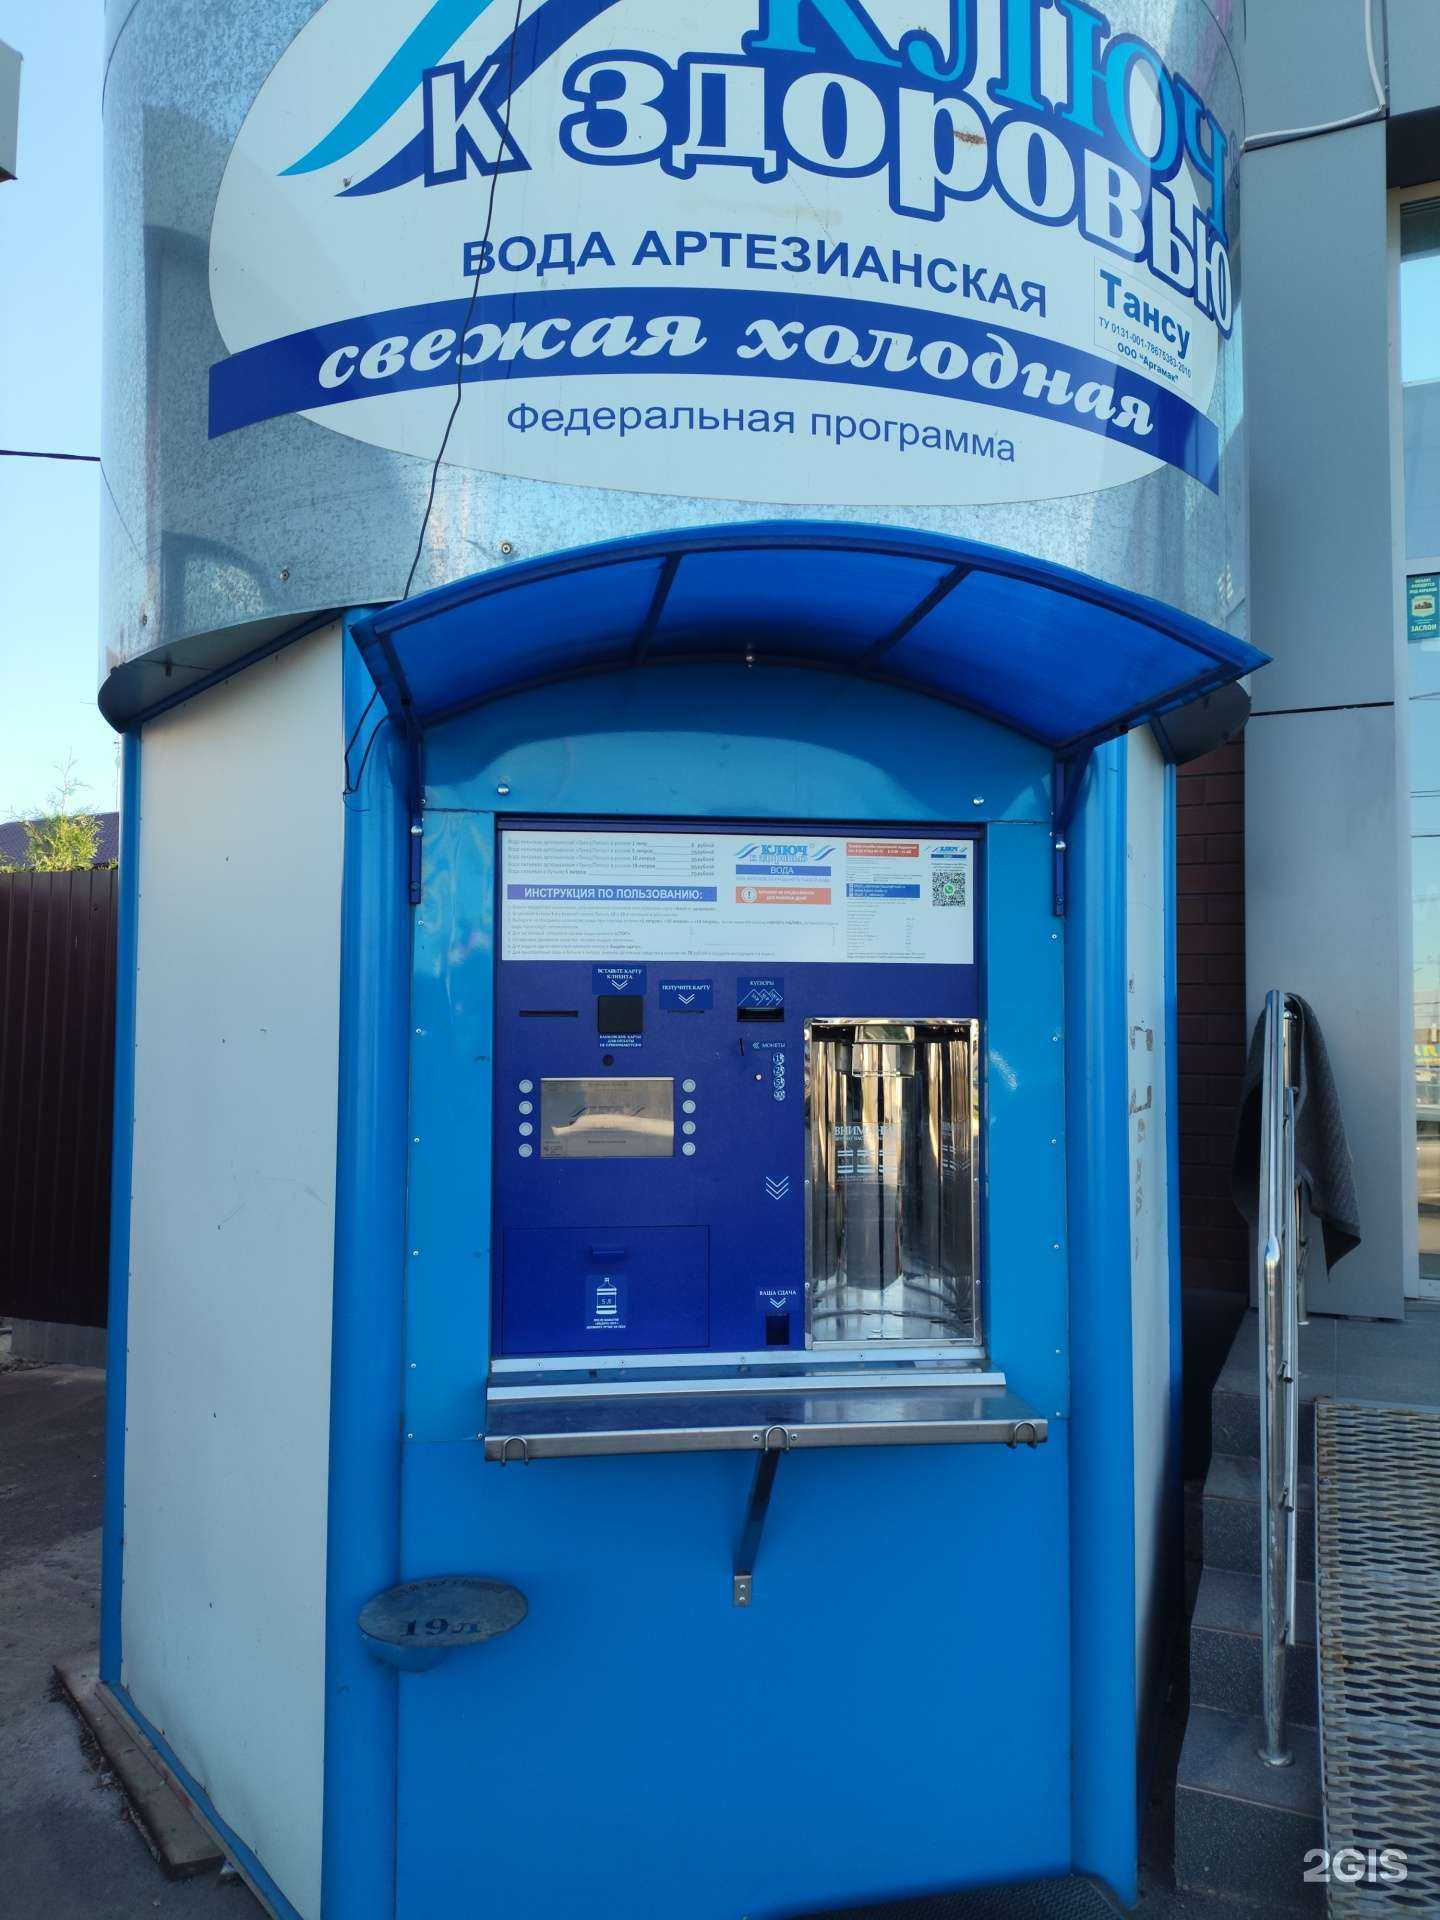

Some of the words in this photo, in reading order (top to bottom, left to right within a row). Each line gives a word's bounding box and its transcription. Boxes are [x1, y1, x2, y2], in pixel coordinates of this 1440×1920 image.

[462, 230, 616, 278] ВОДА
[631, 230, 1048, 318] АРТЕЗИАНСКАЯ
[1099, 268, 1191, 360] Тансу
[317, 314, 708, 389] свежая
[736, 317, 1155, 437] холодная
[1117, 342, 1138, 359] ООО
[506, 402, 796, 438] Федеральная
[811, 412, 1016, 463] программа
[524, 888, 595, 899] ИНСТРУКЦИЯ
[598, 888, 614, 899] ПО
[616, 888, 703, 900] ПОЛЬЗОВАНИЮ:
[770, 865, 795, 875] ВОДА
